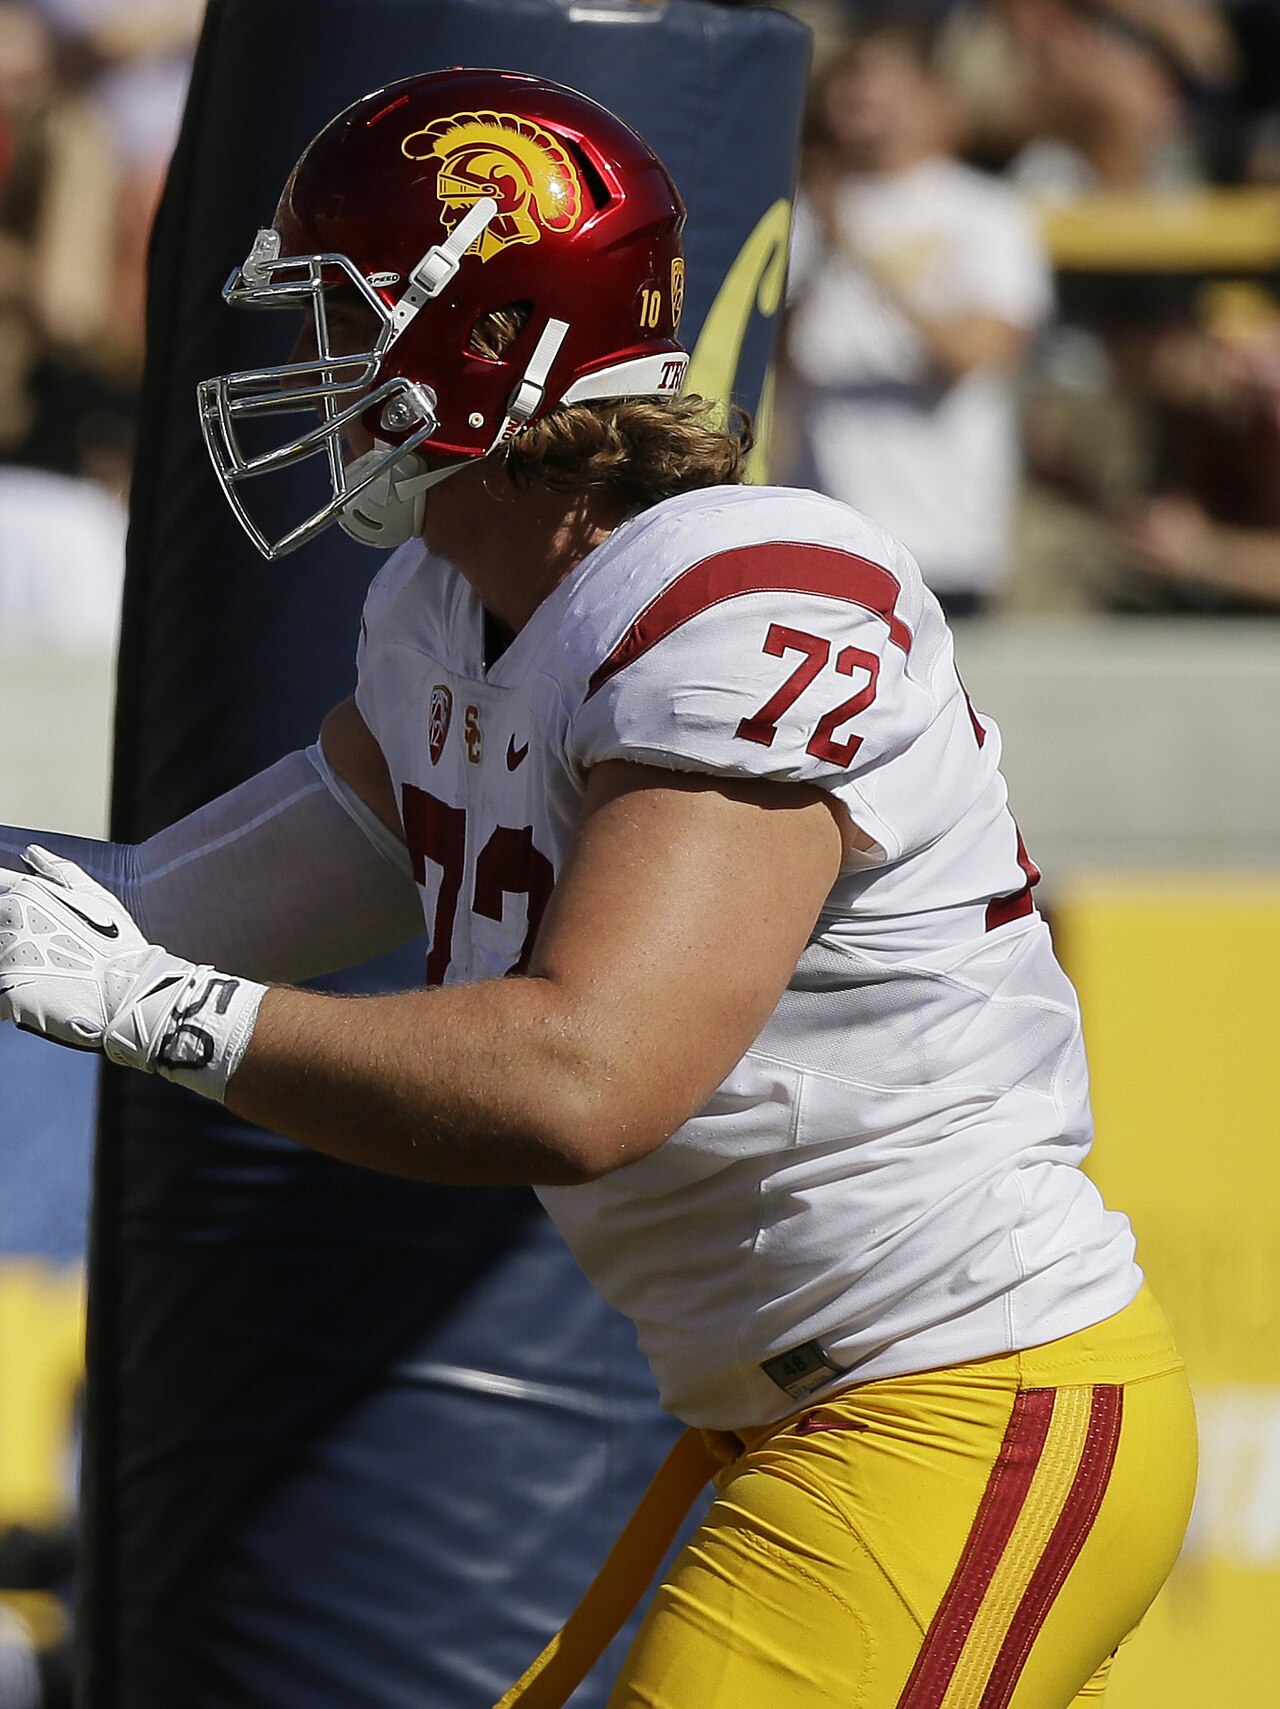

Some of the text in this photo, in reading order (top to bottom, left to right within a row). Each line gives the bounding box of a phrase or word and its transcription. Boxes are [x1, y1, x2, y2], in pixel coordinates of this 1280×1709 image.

[366, 274, 399, 286] SPEED
[639, 289, 662, 328] 10
[733, 622, 881, 769] 72
